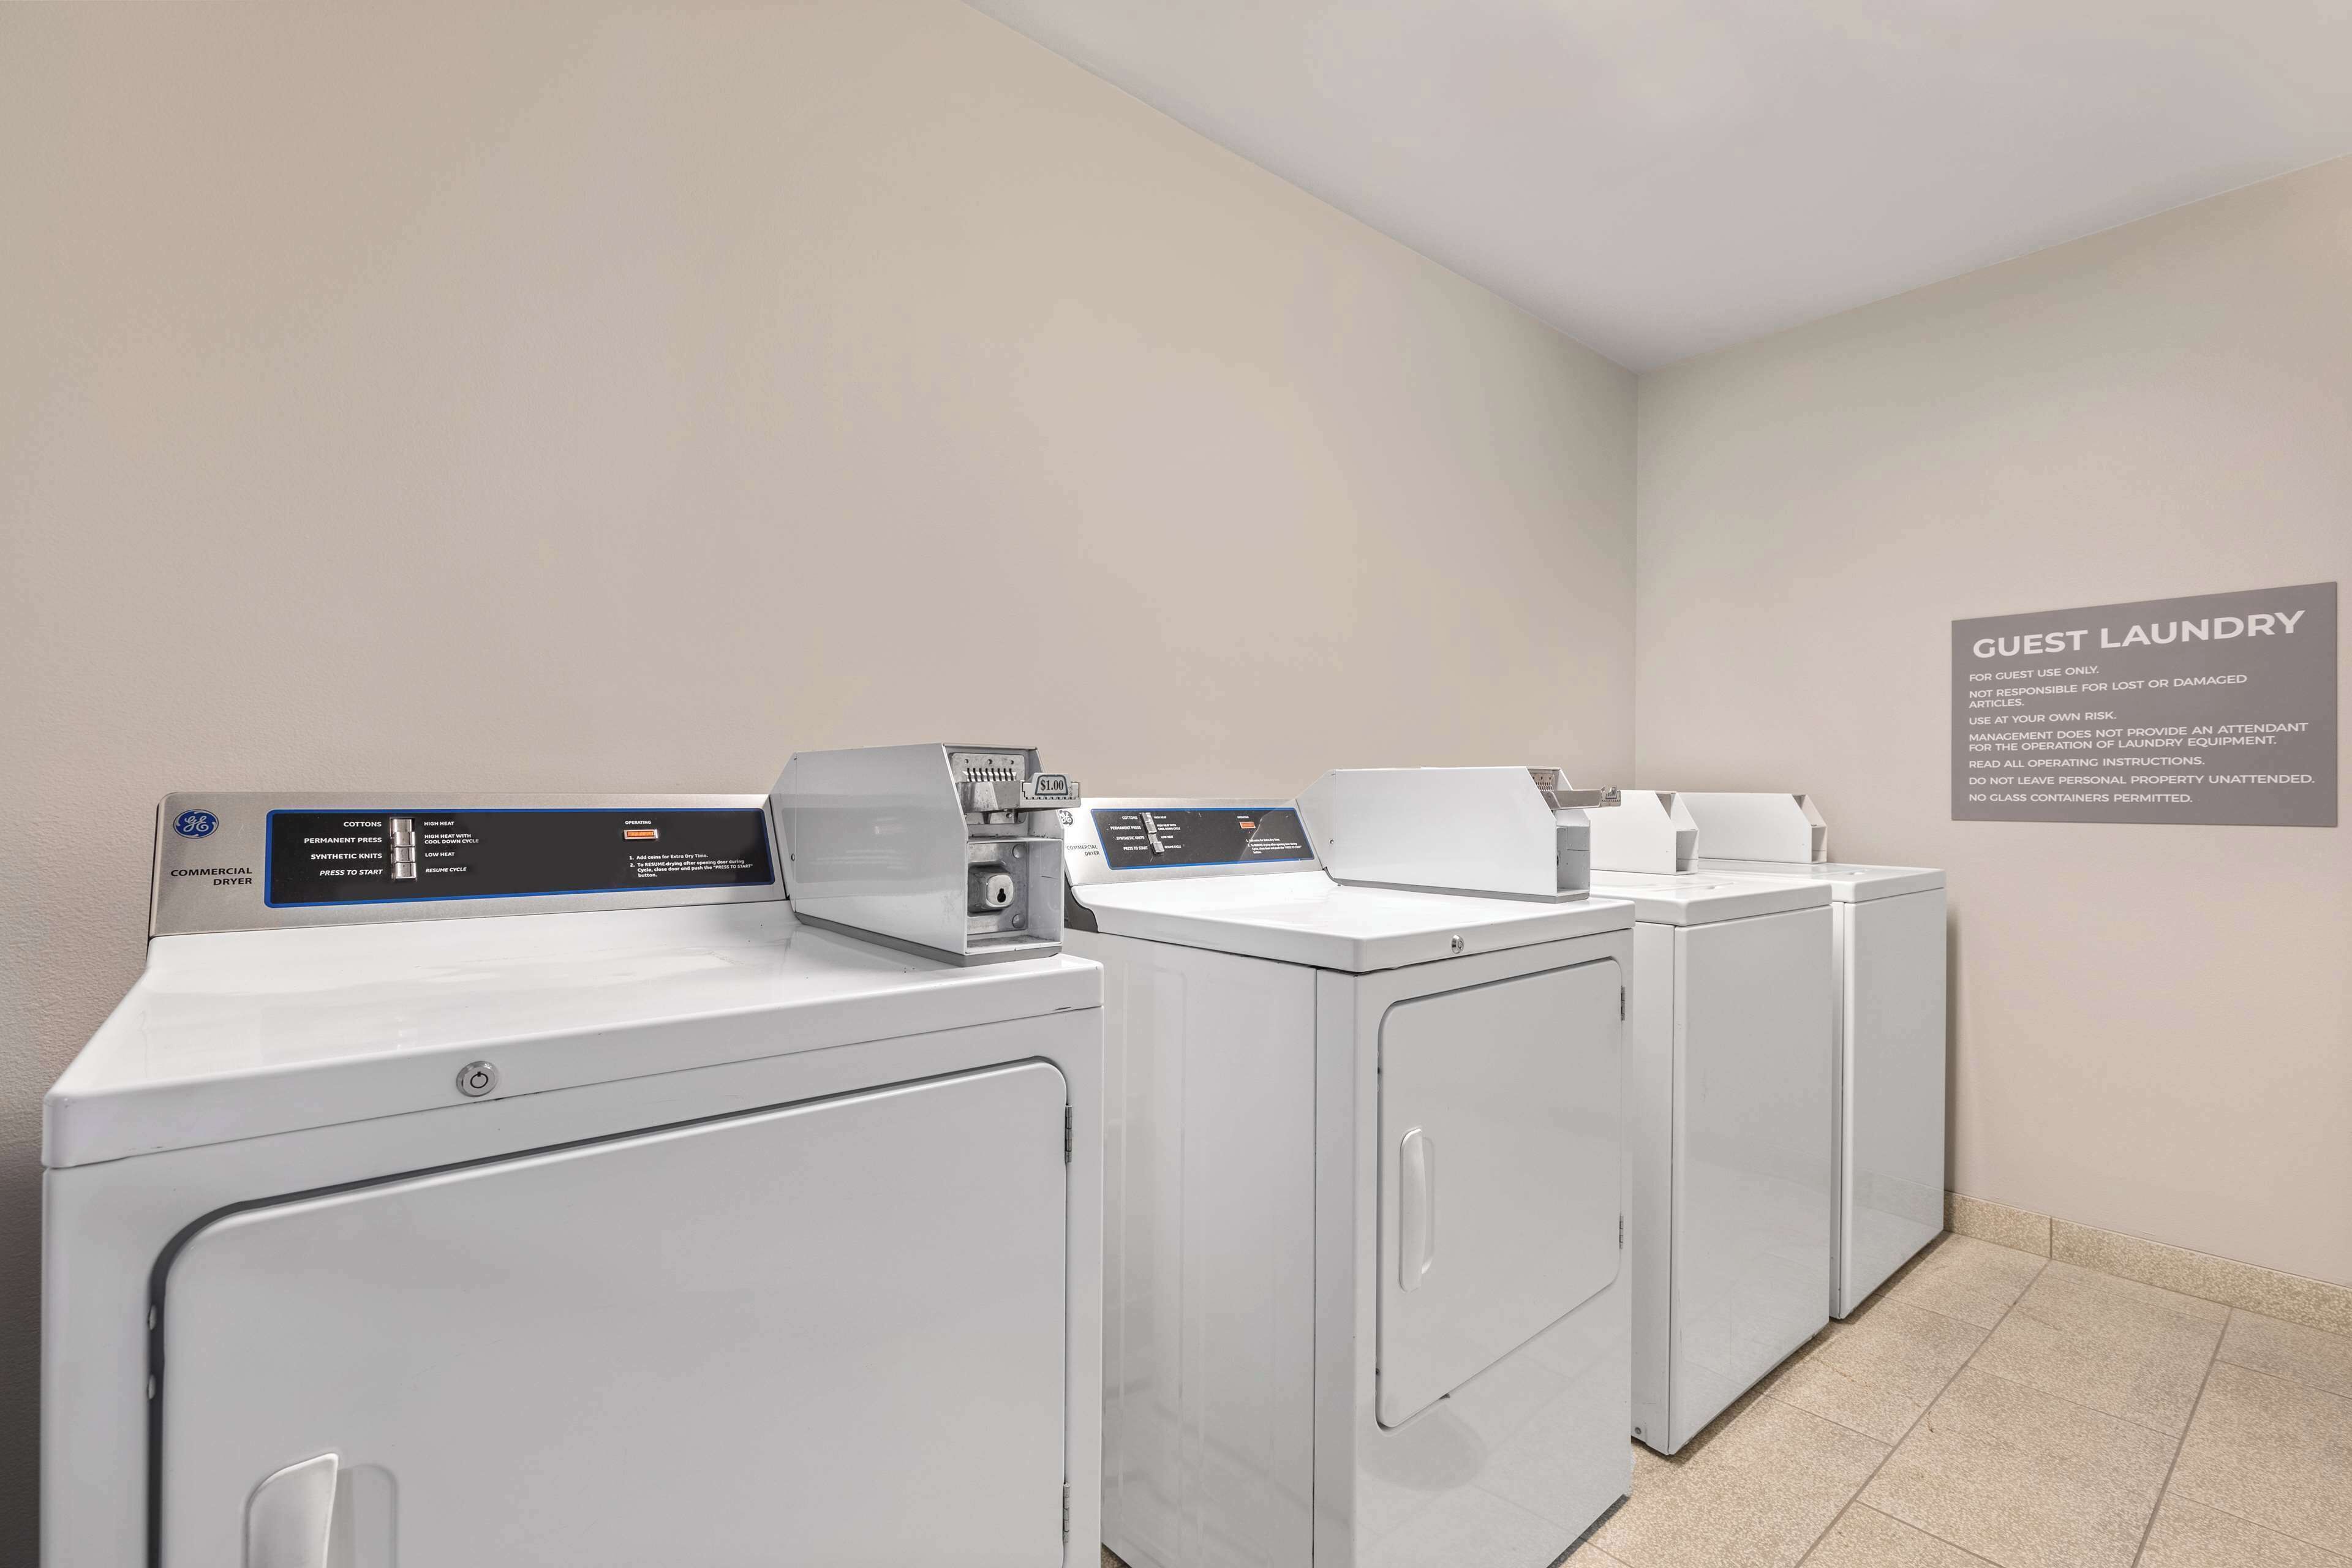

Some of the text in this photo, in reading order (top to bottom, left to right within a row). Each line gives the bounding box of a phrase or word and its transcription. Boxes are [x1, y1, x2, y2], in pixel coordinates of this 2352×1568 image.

[1973, 610, 2305, 658] GUEST LAUNDRY
[1996, 671, 2034, 679] GUEST
[2038, 668, 2061, 677] USE
[2065, 666, 2099, 675] ONLY.
[1997, 685, 2078, 696] RESPONSIBLE
[2082, 683, 2107, 692] FOR
[2113, 681, 2144, 690] LOST
[2149, 679, 2168, 688] OR
[2174, 675, 2247, 687] DAMAGED
[1969, 699, 2024, 708] ARTICLES.
[1970, 731, 2053, 741] MANAGEMENT
[2057, 730, 2091, 739] DOES
[2128, 727, 2187, 736] PROVIDE
[2218, 723, 2308, 734] ATTENDANT
[2022, 741, 2092, 750] OPERATION
[2119, 739, 2183, 748] LAUNDRY
[2188, 736, 2276, 747] EQUIPMENT.
[2103, 757, 2204, 766] INSTRUCTIONS.
[1041, 779, 1063, 791] $1.00
[2209, 775, 2315, 783] UNATTENDED.
[171, 868, 252, 876] COMMERCIAL
